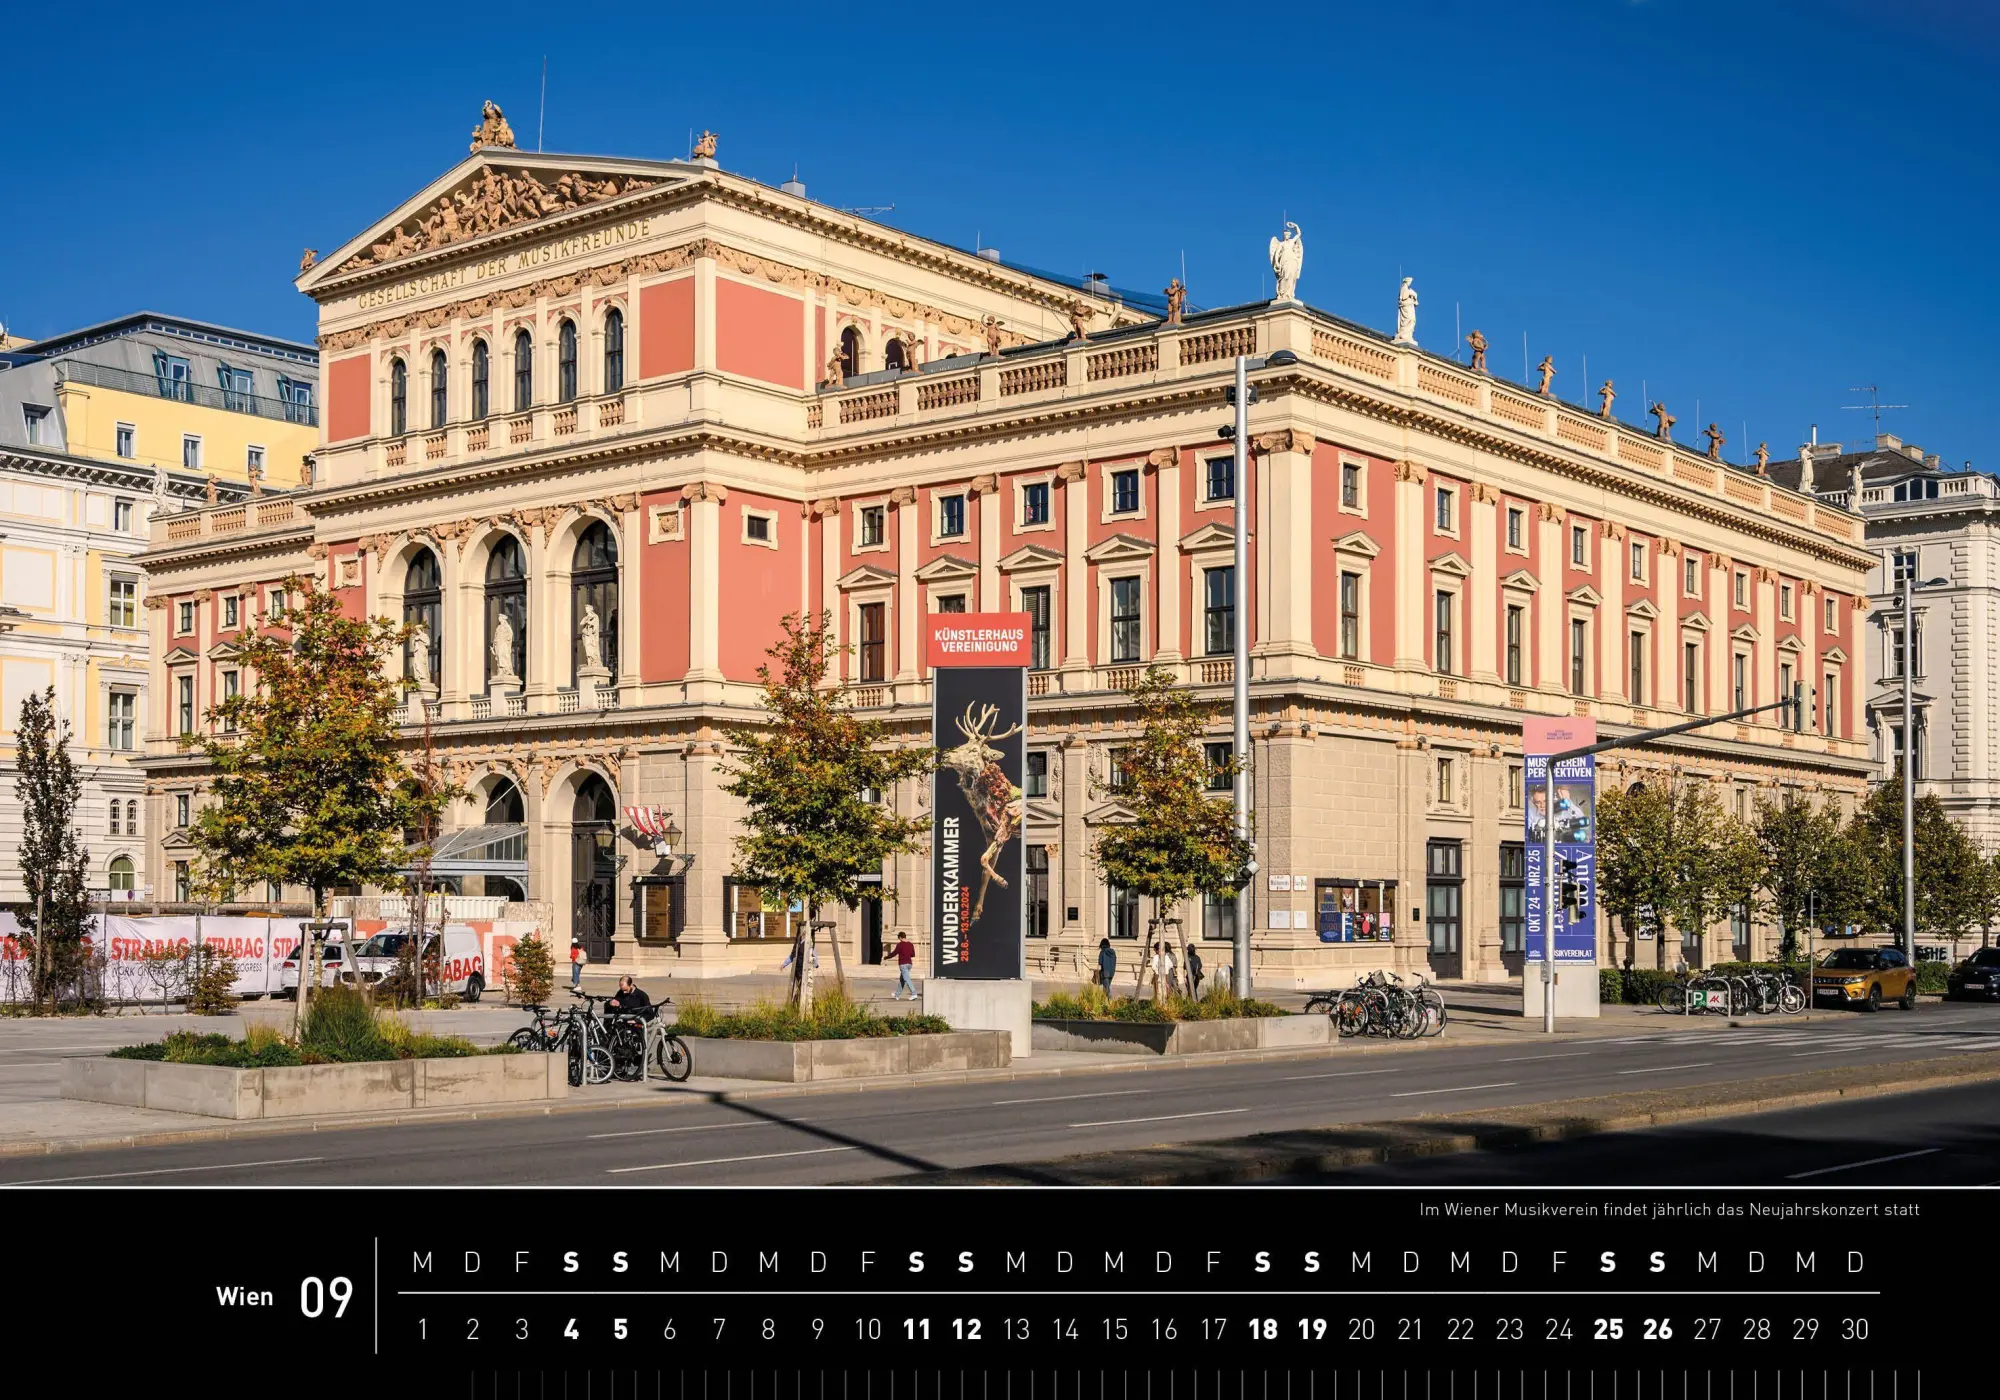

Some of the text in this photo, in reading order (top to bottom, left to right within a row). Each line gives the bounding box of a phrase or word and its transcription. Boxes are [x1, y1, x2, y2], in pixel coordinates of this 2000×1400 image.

[359, 219, 651, 310] GESELLSCHAFT DER MUSIKFREUNDE
[935, 627, 1024, 641] KÜNSTLERHAUS
[941, 641, 1018, 653] VEREINIGUNG
[1528, 849, 1541, 863] 25
[1528, 864, 1541, 887] MRZ
[943, 816, 959, 965] WUNDERKAMMER
[1528, 897, 1540, 910] 24
[1528, 911, 1541, 932] OKT
[1693, 992, 1703, 1006] P
